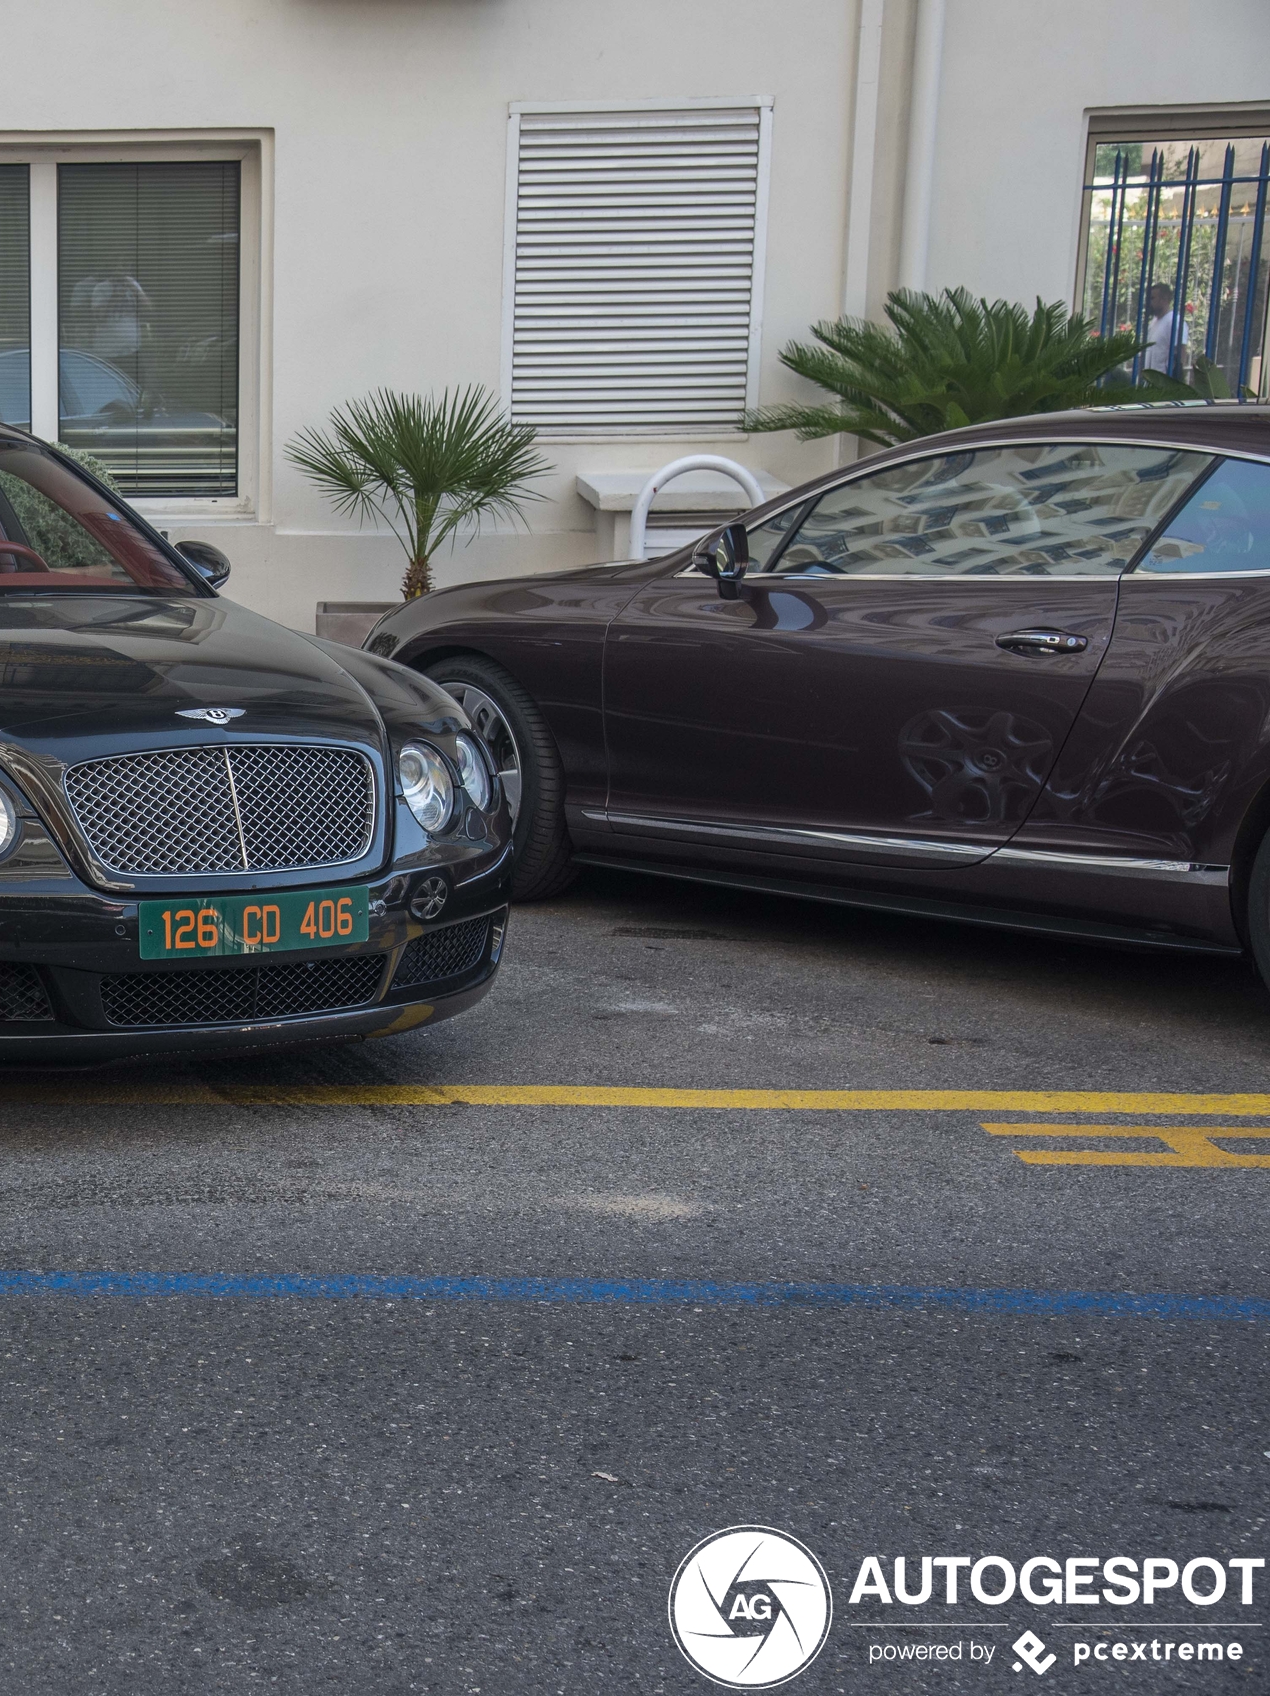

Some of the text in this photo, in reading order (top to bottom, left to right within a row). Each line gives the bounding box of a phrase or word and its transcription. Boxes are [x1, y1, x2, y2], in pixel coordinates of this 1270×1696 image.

[161, 897, 353, 949] 126 CD 406
